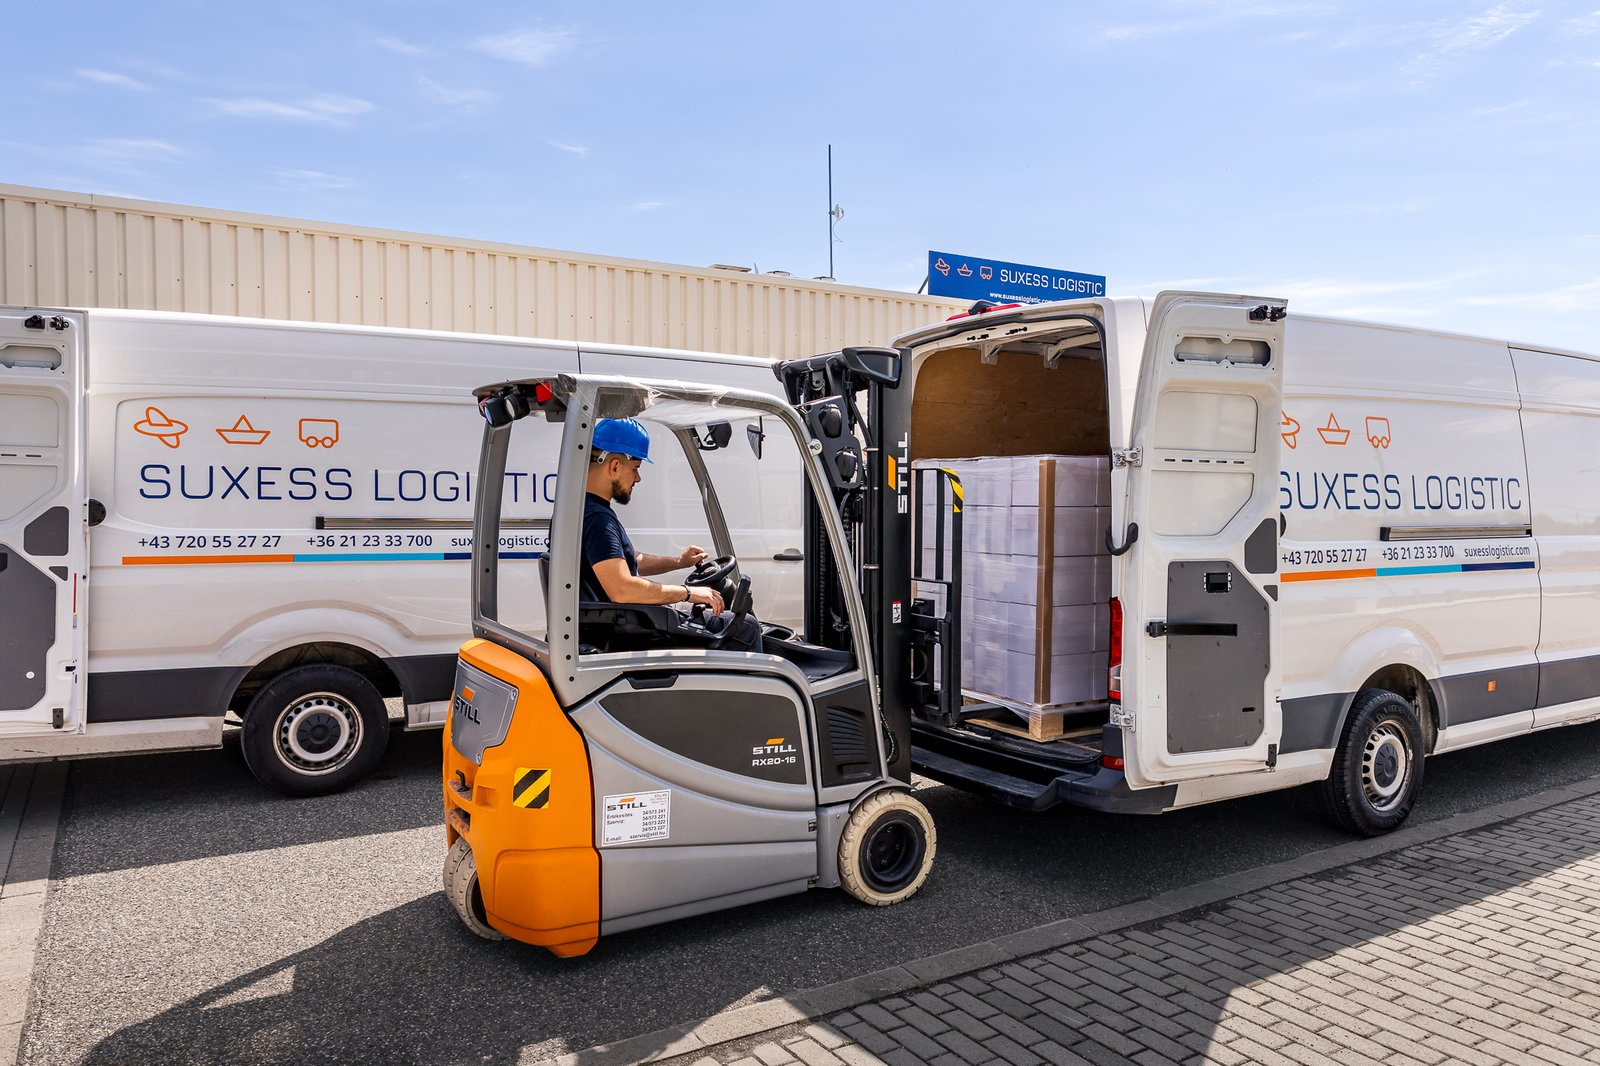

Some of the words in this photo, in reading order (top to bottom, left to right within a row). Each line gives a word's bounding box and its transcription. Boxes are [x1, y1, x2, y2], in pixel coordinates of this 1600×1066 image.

[1000, 269, 1049, 288] SUXESS
[1052, 276, 1103, 295] LOGISTIC
[139, 463, 353, 501] SUXESS
[373, 468, 558, 503] LOGITIC
[897, 432, 908, 514] STILL
[1280, 470, 1402, 510] SUXESS
[1411, 474, 1522, 511] LOGISTIC
[138, 536, 170, 549] +43
[175, 535, 207, 549] 720
[212, 535, 232, 548] 55
[237, 535, 257, 548] 27
[262, 535, 281, 548] 27
[307, 535, 335, 547] +36
[340, 535, 356, 547] 21
[362, 534, 380, 547] 23
[385, 534, 402, 547] 33
[406, 534, 433, 547] 700
[1282, 551, 1302, 565] +43
[1304, 550, 1324, 564] 720
[1326, 549, 1339, 563] 55
[1341, 548, 1353, 562] 27
[1355, 548, 1367, 562] 27
[1382, 547, 1399, 560] +36
[1400, 547, 1412, 560] 21
[1413, 546, 1425, 559] 23
[1427, 546, 1438, 559] 33
[1438, 545, 1455, 558] 700
[1464, 544, 1531, 559] suxesslogistic.com
[455, 694, 481, 726] STILL
[752, 744, 797, 755] STILL
[752, 756, 796, 767] RX20-16
[607, 802, 647, 811] STILL
